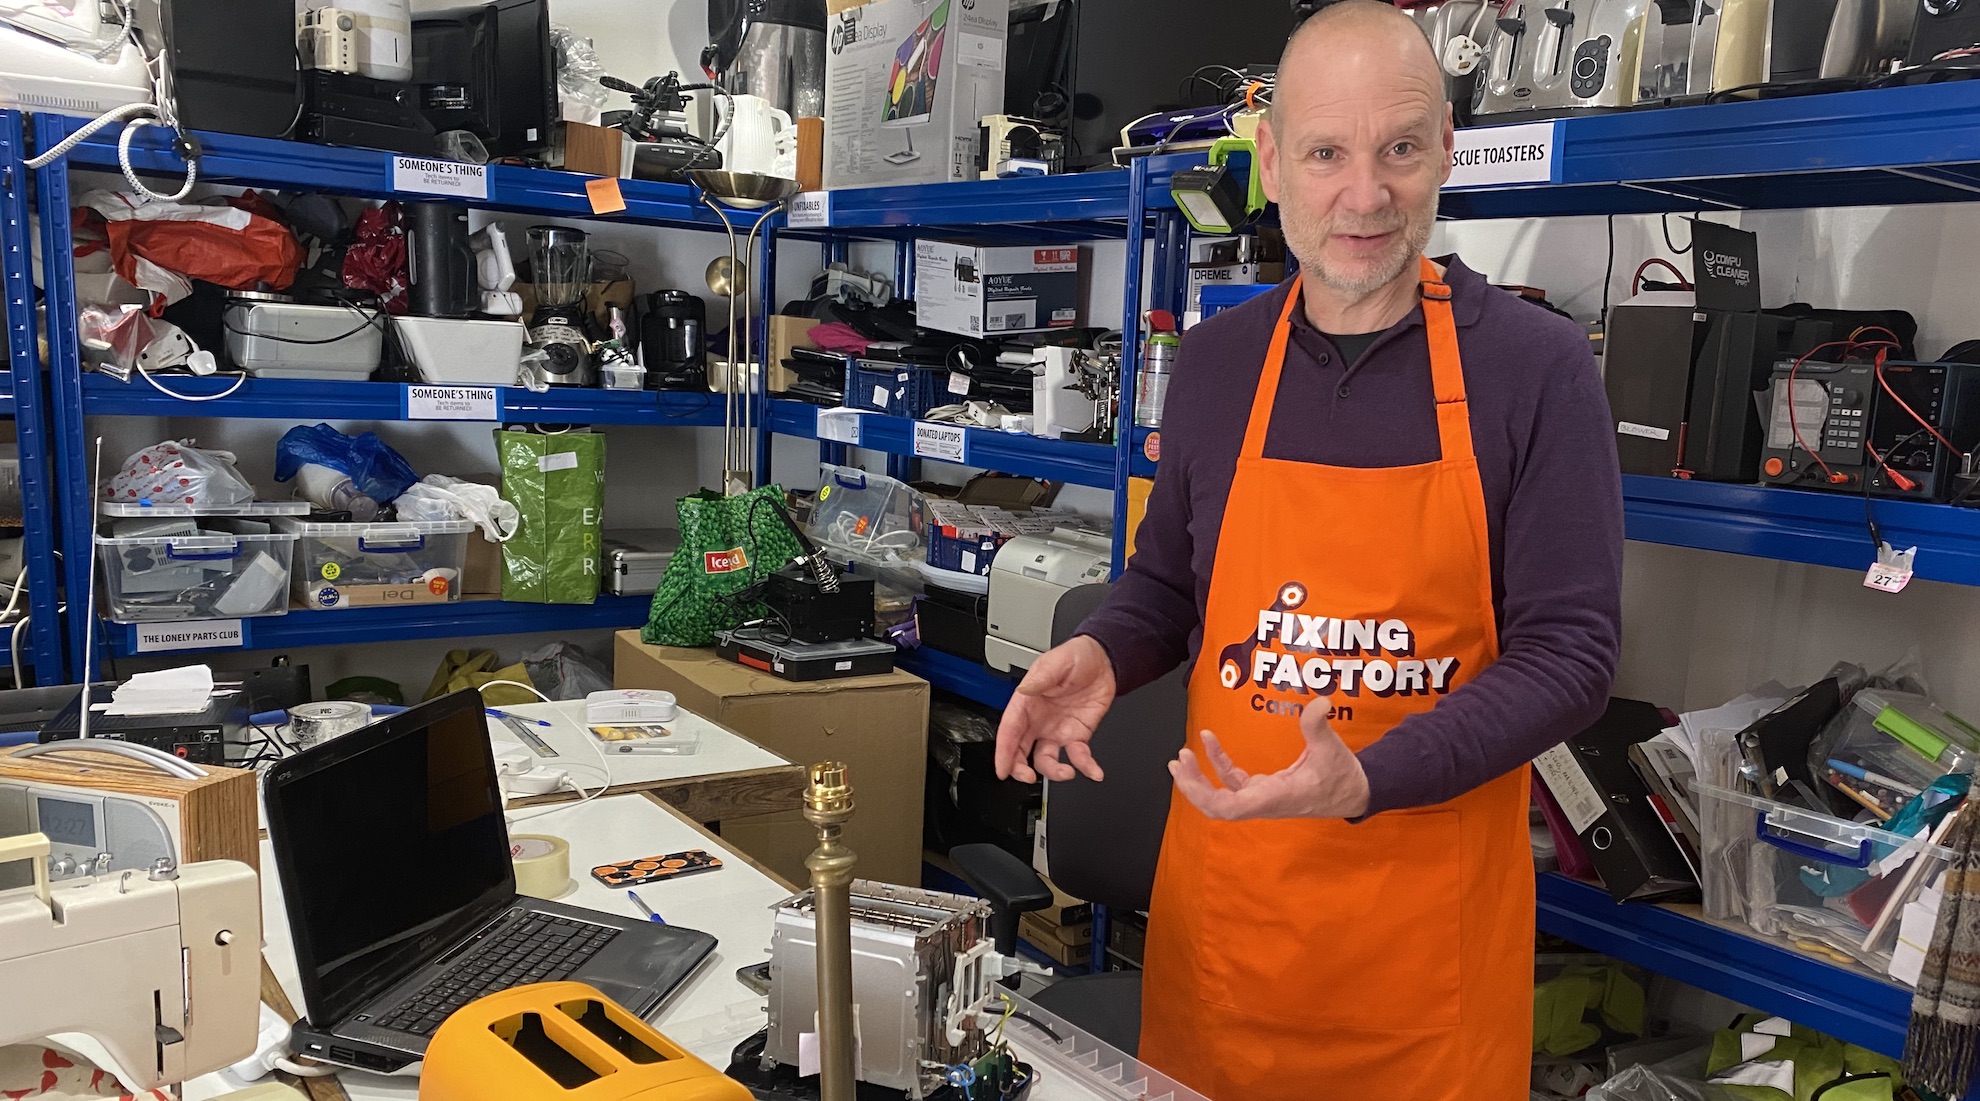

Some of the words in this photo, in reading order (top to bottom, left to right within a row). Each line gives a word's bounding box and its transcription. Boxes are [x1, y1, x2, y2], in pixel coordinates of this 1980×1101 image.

[978, 16, 998, 28] Display
[863, 23, 887, 41] Display
[1452, 149, 1481, 167] SCUE
[1483, 144, 1545, 165] TOASTERS
[399, 159, 453, 174] SOMEONE'S
[454, 164, 483, 177] THING
[425, 172, 438, 180] Tech
[1715, 254, 1742, 268] COMPU
[988, 275, 1012, 285] AOYUE
[1194, 270, 1233, 280] DREMEL
[1716, 265, 1750, 283] CLEANER
[987, 286, 1003, 294] Digital
[412, 388, 464, 400] SOMEONE'S
[466, 390, 493, 400] THING
[917, 427, 938, 440] DONATED
[939, 430, 961, 443] LAPTOPS
[711, 553, 740, 568] Iced
[1873, 574, 1892, 587] 27
[143, 635, 159, 643] THE
[161, 633, 191, 643] LONELY
[192, 632, 218, 641] PARTS
[219, 631, 239, 639] CLUB
[1257, 610, 1411, 654] FIXING
[1253, 649, 1458, 695] FACTORY
[1250, 693, 1353, 721] Camen
